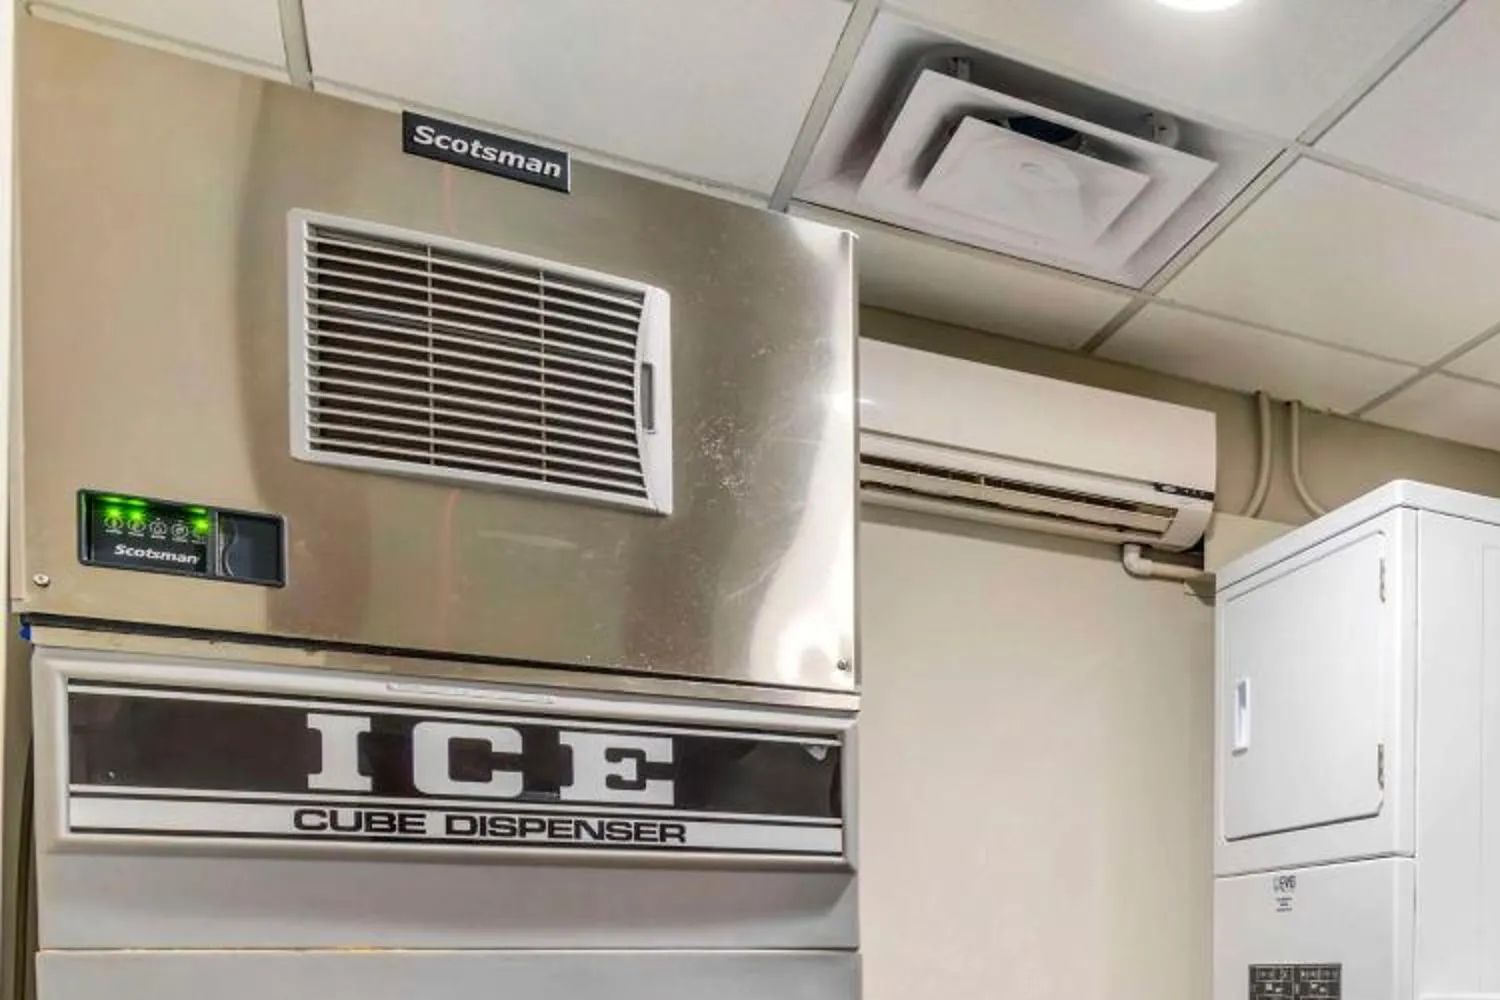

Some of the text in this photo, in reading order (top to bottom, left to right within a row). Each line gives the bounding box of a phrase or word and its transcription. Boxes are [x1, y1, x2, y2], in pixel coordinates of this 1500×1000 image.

[413, 125, 561, 178] Scotsman
[114, 544, 200, 565] Scotsman
[306, 712, 675, 806] ICE
[293, 809, 687, 844] CUBE DISPENSER
